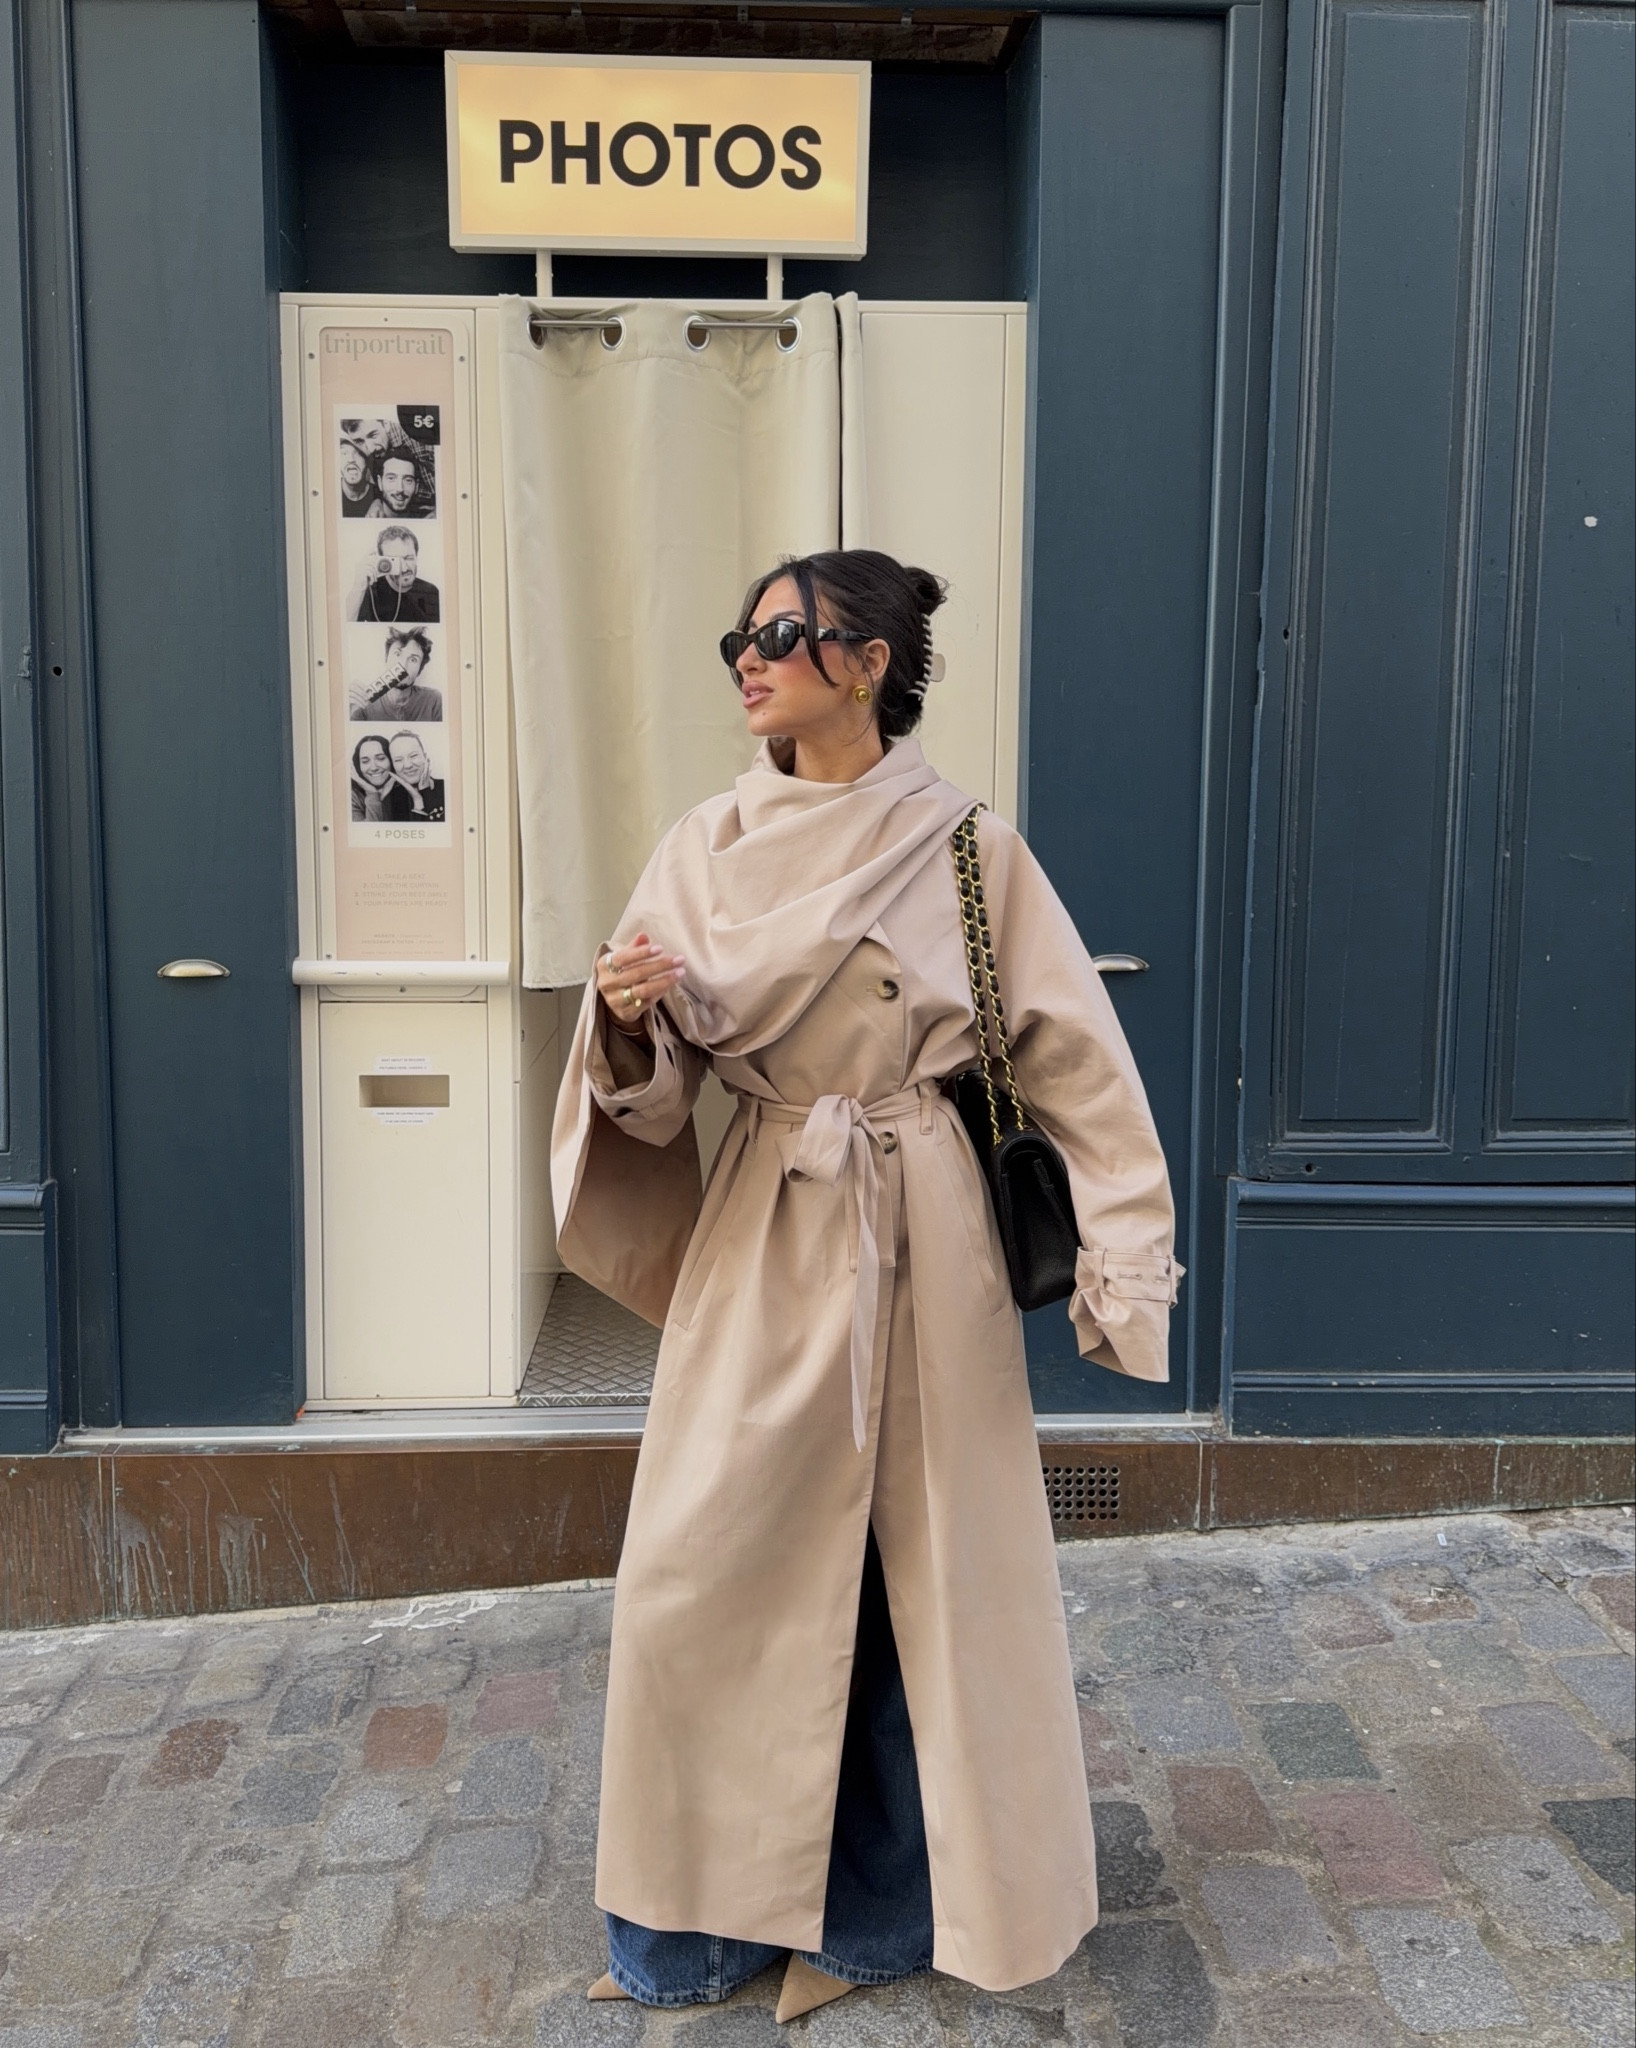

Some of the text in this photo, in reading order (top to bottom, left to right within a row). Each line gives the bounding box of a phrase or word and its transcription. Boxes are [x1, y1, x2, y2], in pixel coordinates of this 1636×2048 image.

[499, 119, 822, 190] PHOTOS
[325, 333, 446, 361] triportrait
[413, 415, 434, 428] 5€
[374, 829, 426, 839] 4 POSES
